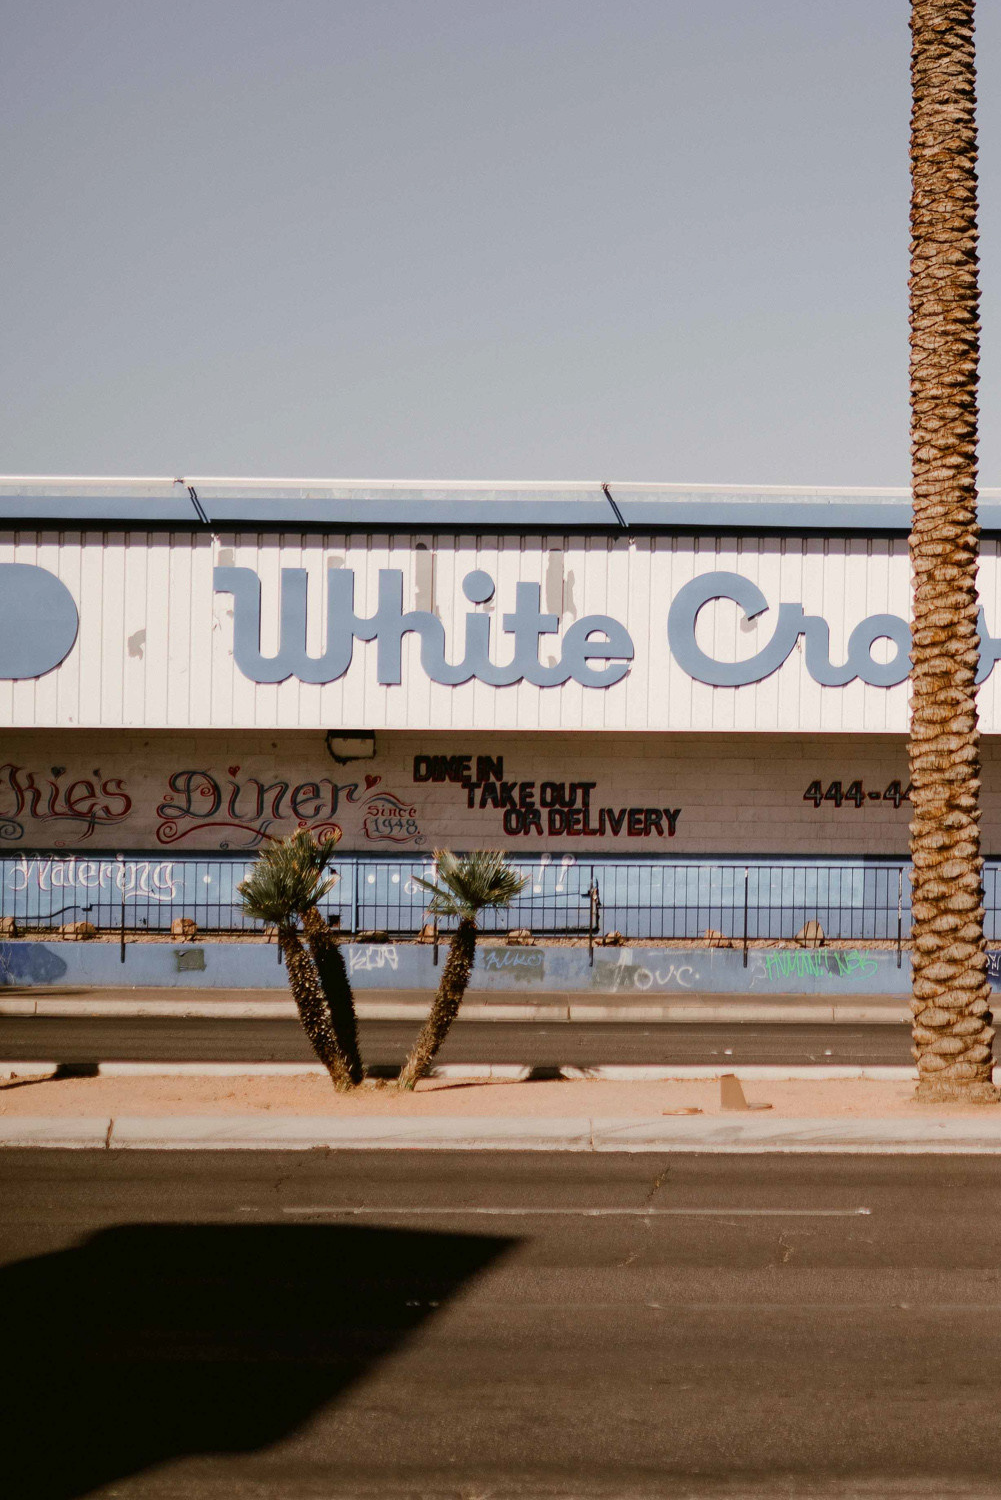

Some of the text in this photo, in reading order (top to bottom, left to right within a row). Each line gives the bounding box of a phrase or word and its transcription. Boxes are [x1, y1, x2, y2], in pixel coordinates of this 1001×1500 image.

[212, 566, 635, 688] White
[413, 754, 504, 783] DINE IN
[156, 765, 360, 822] Diner
[461, 781, 597, 810] TAKE OUT
[366, 804, 417, 818] Since
[503, 807, 682, 837] OR DELIVERY
[8, 853, 186, 902] Watering
